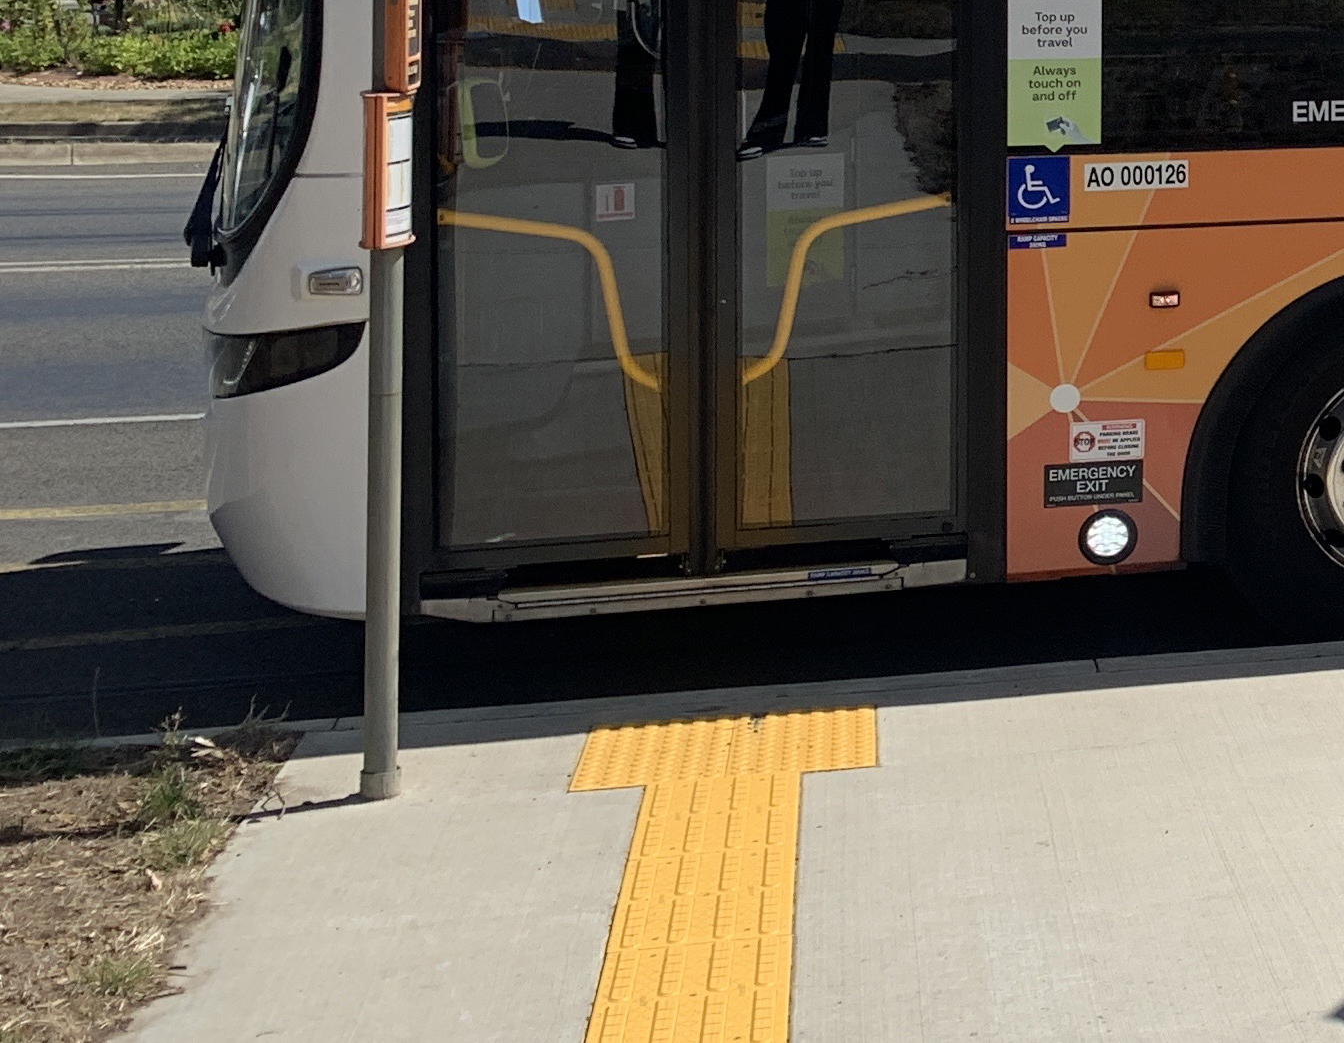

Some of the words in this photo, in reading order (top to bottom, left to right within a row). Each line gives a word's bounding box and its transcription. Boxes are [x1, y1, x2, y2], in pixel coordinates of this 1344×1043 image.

[1035, 12, 1057, 24] Top
[1060, 14, 1075, 24] up
[1022, 24, 1062, 35] before
[1066, 26, 1087, 37] you
[1037, 37, 1072, 48] travel
[1033, 65, 1076, 78] Always
[1028, 78, 1063, 89] touch
[1066, 80, 1081, 88] on
[1032, 91, 1055, 101] and
[1058, 90, 1076, 101] off
[1087, 166, 1115, 188] AO
[1120, 164, 1187, 186] 000126
[1074, 438, 1095, 447] STOP
[1049, 465, 1136, 482] EMERGENCY
[1076, 479, 1109, 493] EXIT
[1068, 493, 1093, 501] BUTTON
